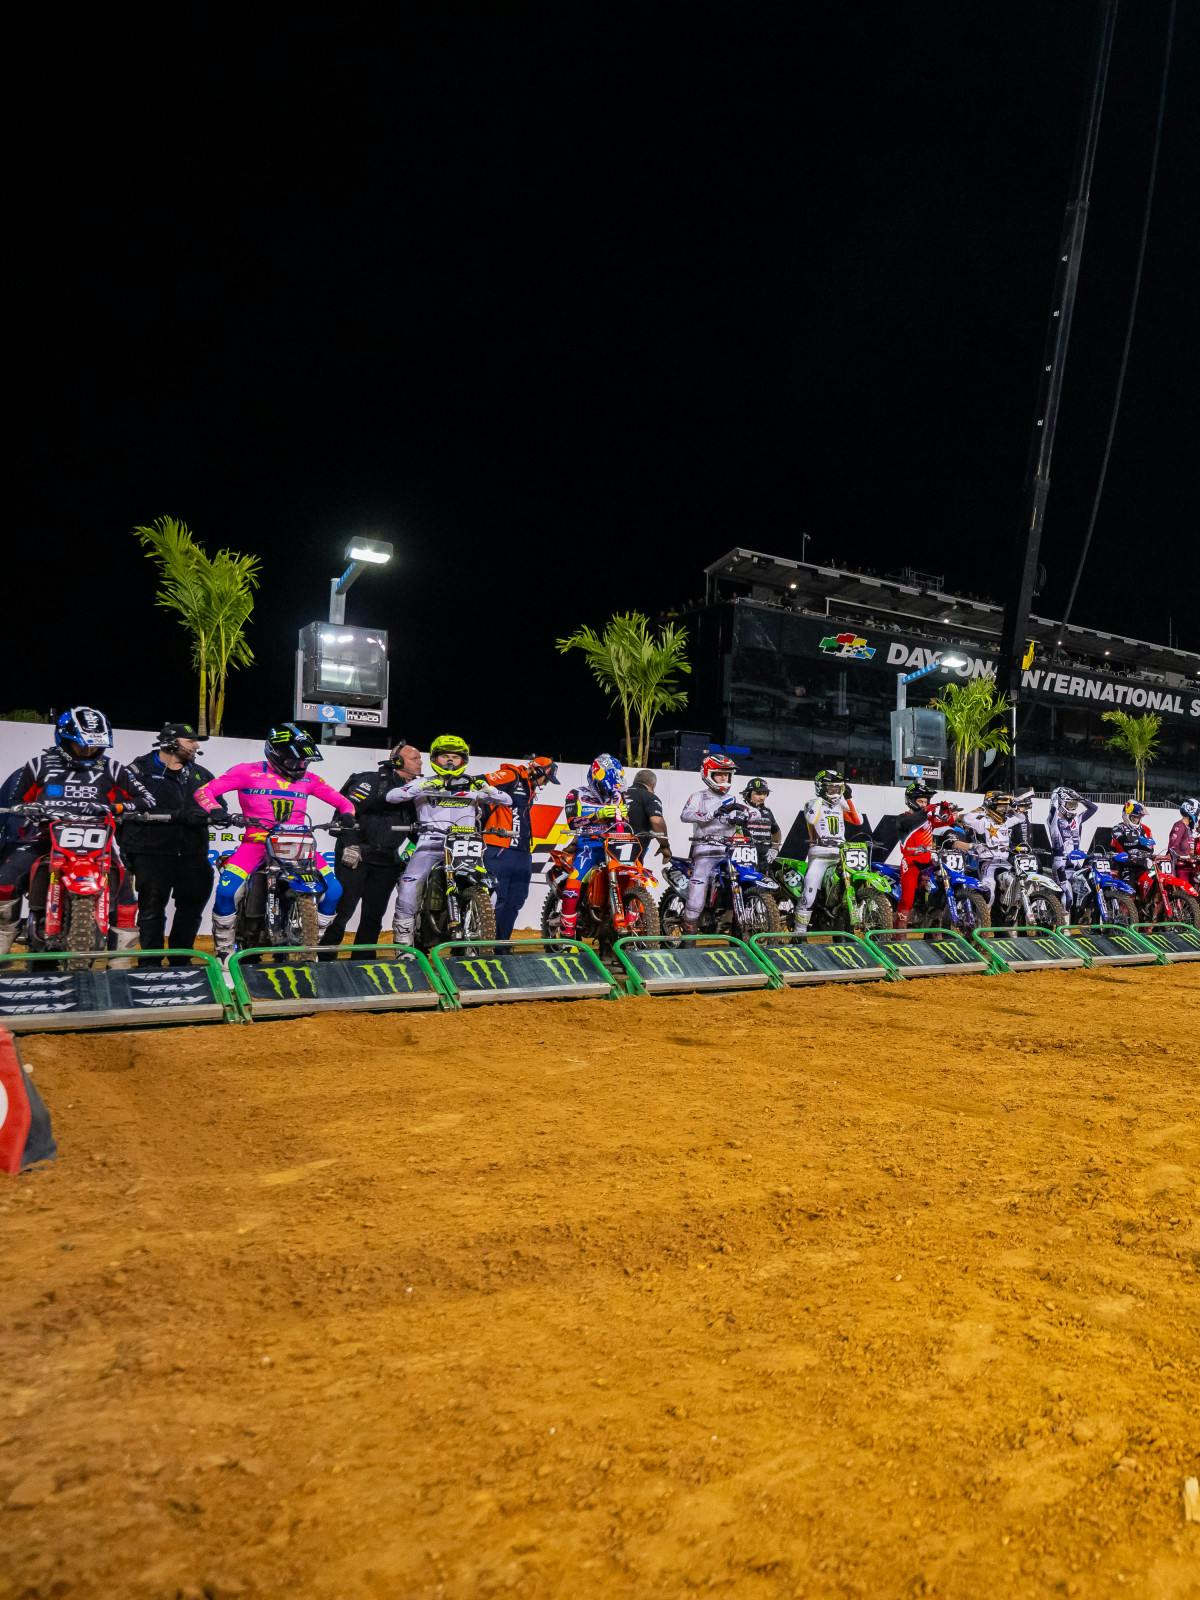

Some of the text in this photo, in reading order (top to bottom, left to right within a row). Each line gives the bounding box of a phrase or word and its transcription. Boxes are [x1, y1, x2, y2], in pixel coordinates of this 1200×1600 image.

[886, 642, 998, 682] DAYON
[1020, 669, 1185, 715] NTERNATIONAL
[44, 769, 104, 784] FLY
[64, 791, 97, 799] LOCK
[65, 785, 98, 793] QUAD
[58, 828, 107, 849] 60
[453, 840, 483, 857] 83
[615, 843, 634, 861] 1
[845, 850, 868, 868] 56
[946, 854, 964, 870] 87
[1019, 859, 1038, 871] 24
[1160, 861, 1172, 874] 10
